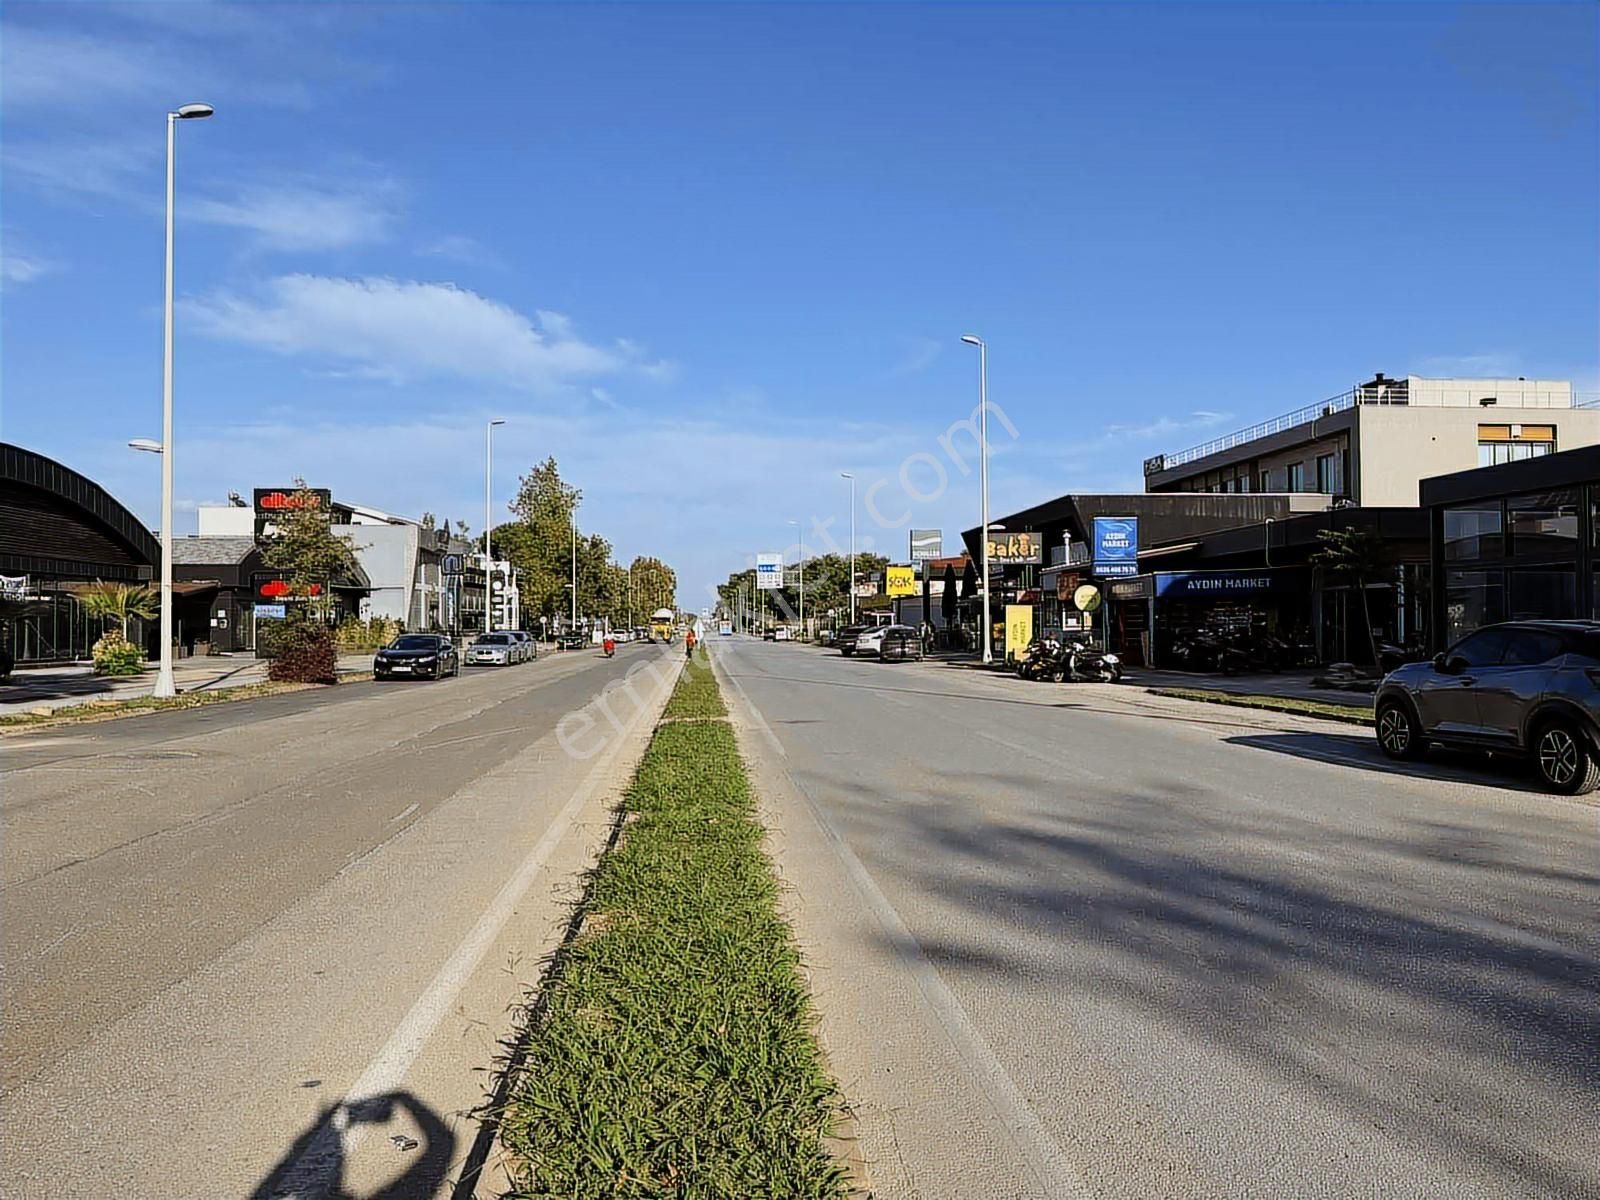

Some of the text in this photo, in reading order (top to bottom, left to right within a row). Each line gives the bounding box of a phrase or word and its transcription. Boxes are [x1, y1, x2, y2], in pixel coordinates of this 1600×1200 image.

[986, 534, 1040, 556] Baker
[1187, 578, 1272, 589] AYDIN MARKET
